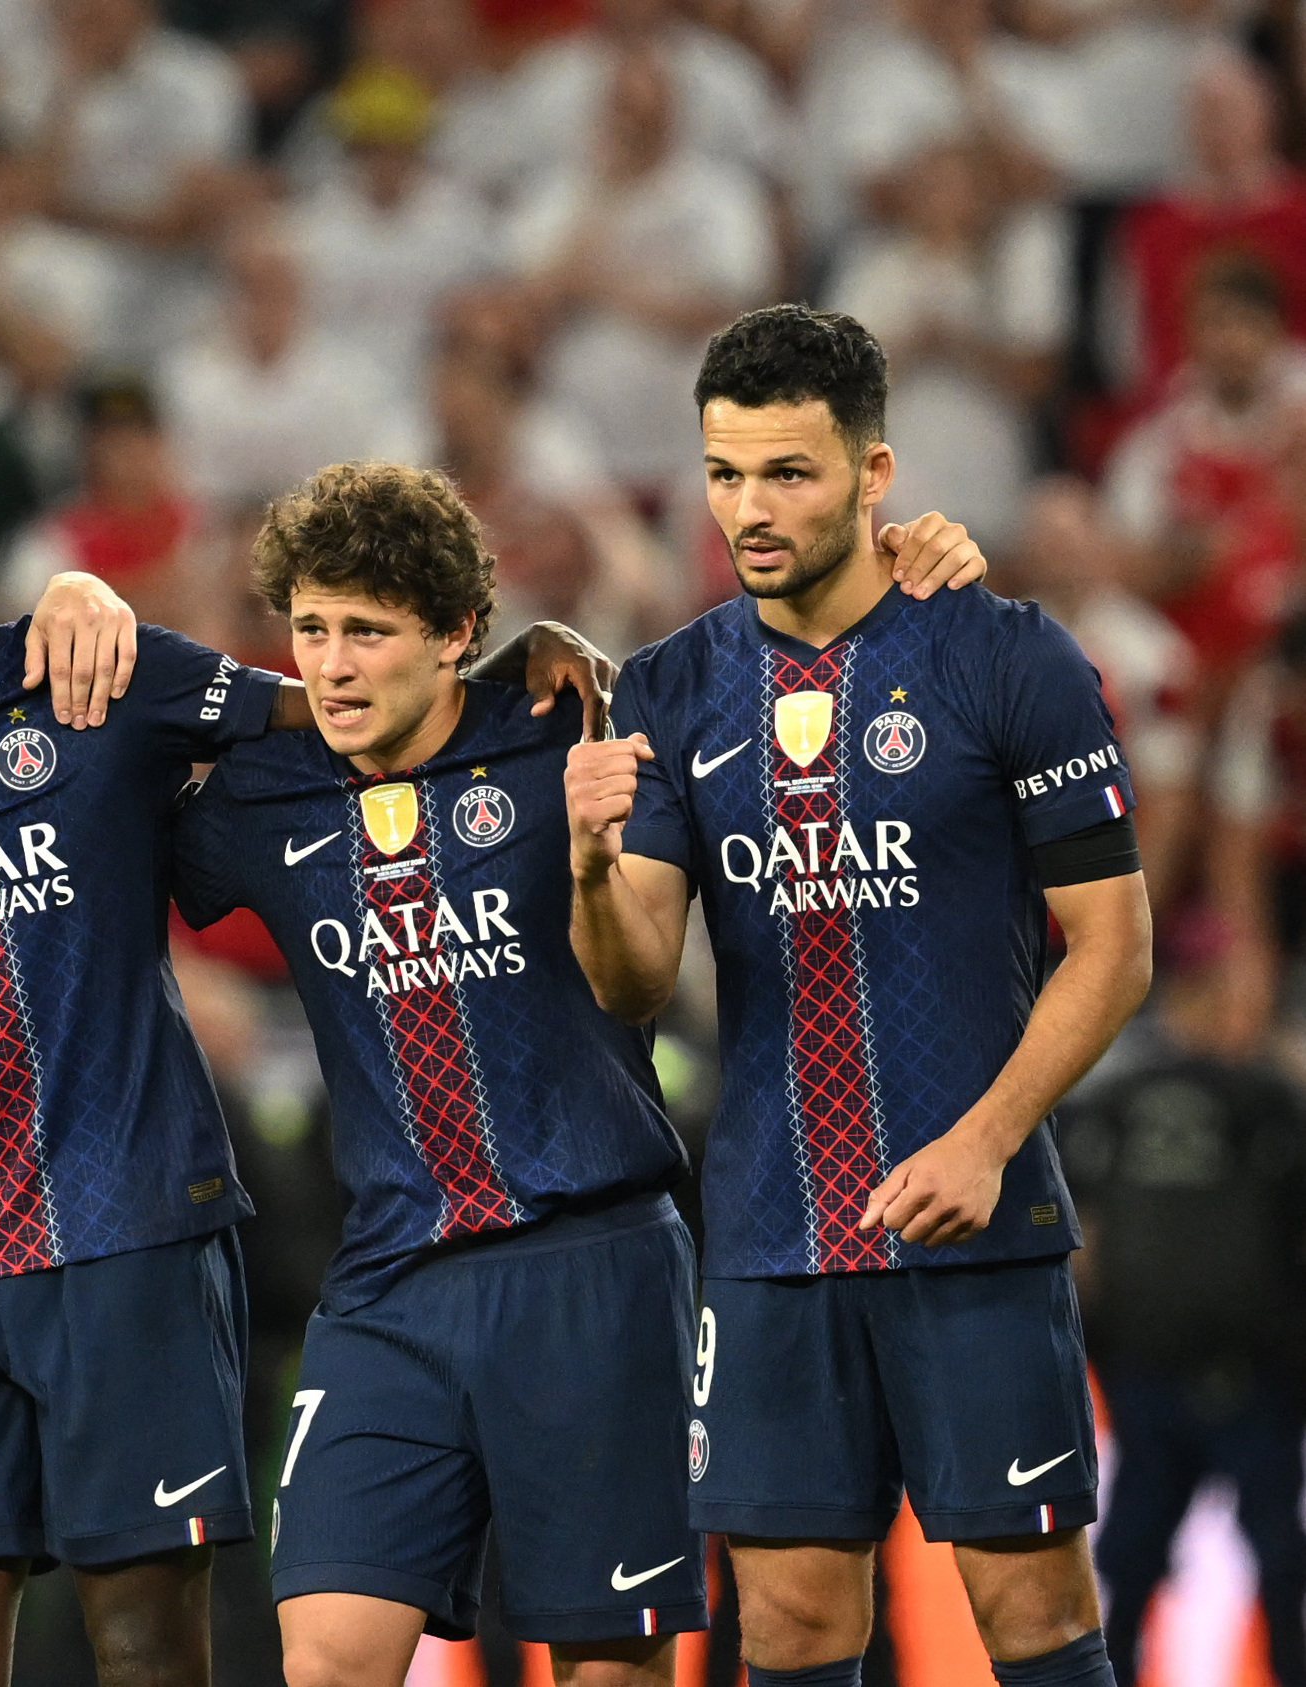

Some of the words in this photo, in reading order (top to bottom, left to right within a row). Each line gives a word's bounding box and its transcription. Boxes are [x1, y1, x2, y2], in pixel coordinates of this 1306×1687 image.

[199, 653, 240, 720] BEYO
[1, 731, 41, 752] PARIS
[875, 714, 915, 730] PARIS
[460, 789, 501, 807] PARIS
[1014, 744, 1119, 799] BEYOND
[720, 820, 918, 893] QATAR
[769, 875, 920, 916] AIRWAYS
[310, 888, 520, 979] QATAR
[366, 942, 526, 998] AIRWAYS
[693, 1306, 716, 1407] 9
[280, 1389, 326, 1487] 7
